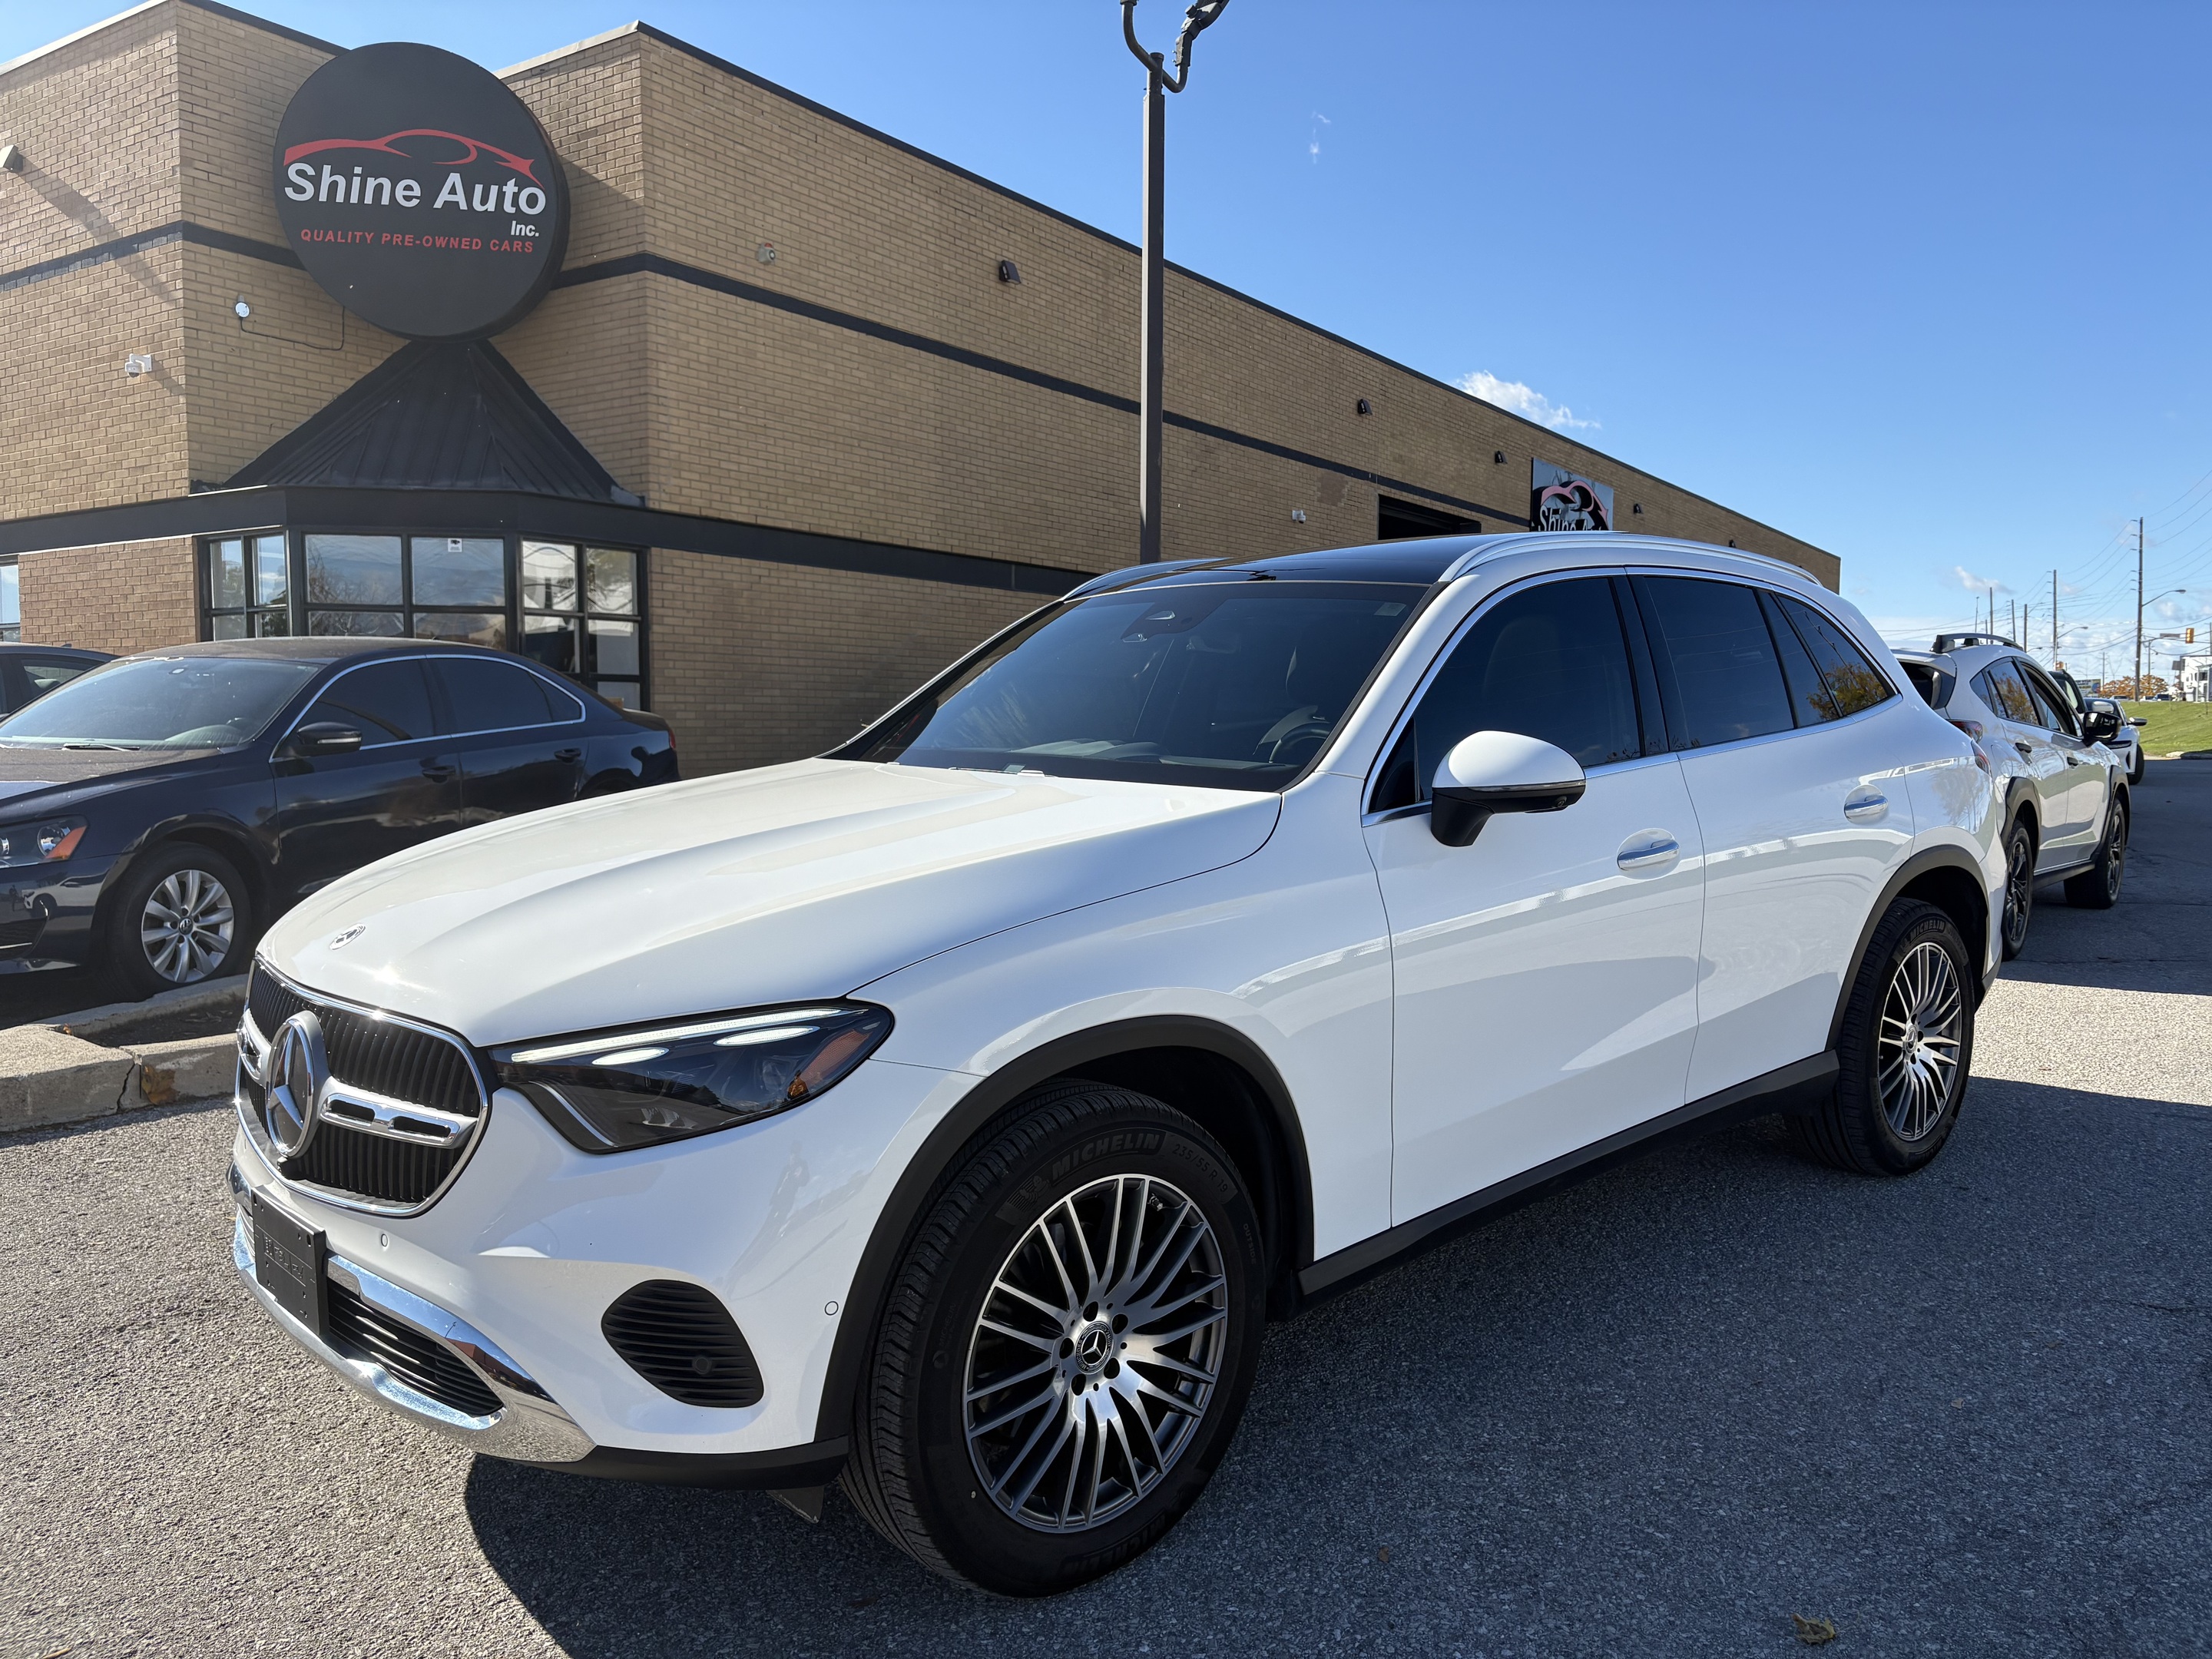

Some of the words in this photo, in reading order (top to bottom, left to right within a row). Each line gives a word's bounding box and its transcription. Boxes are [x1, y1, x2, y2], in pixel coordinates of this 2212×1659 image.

[284, 162, 422, 207] Shine
[432, 172, 546, 215] Auto
[300, 228, 375, 245] QUALITY
[381, 233, 482, 250] PRE-OWNED
[489, 239, 534, 253] CARS
[510, 220, 540, 237] Inc.
[1910, 919, 1945, 942] MICHELIN
[1051, 1132, 1161, 1181] MICHELIN
[1172, 1143, 1210, 1173] 235/55
[1208, 1169, 1218, 1181] R
[1216, 1179, 1229, 1193] 19
[1243, 1223, 1257, 1266] OUTSIDE
